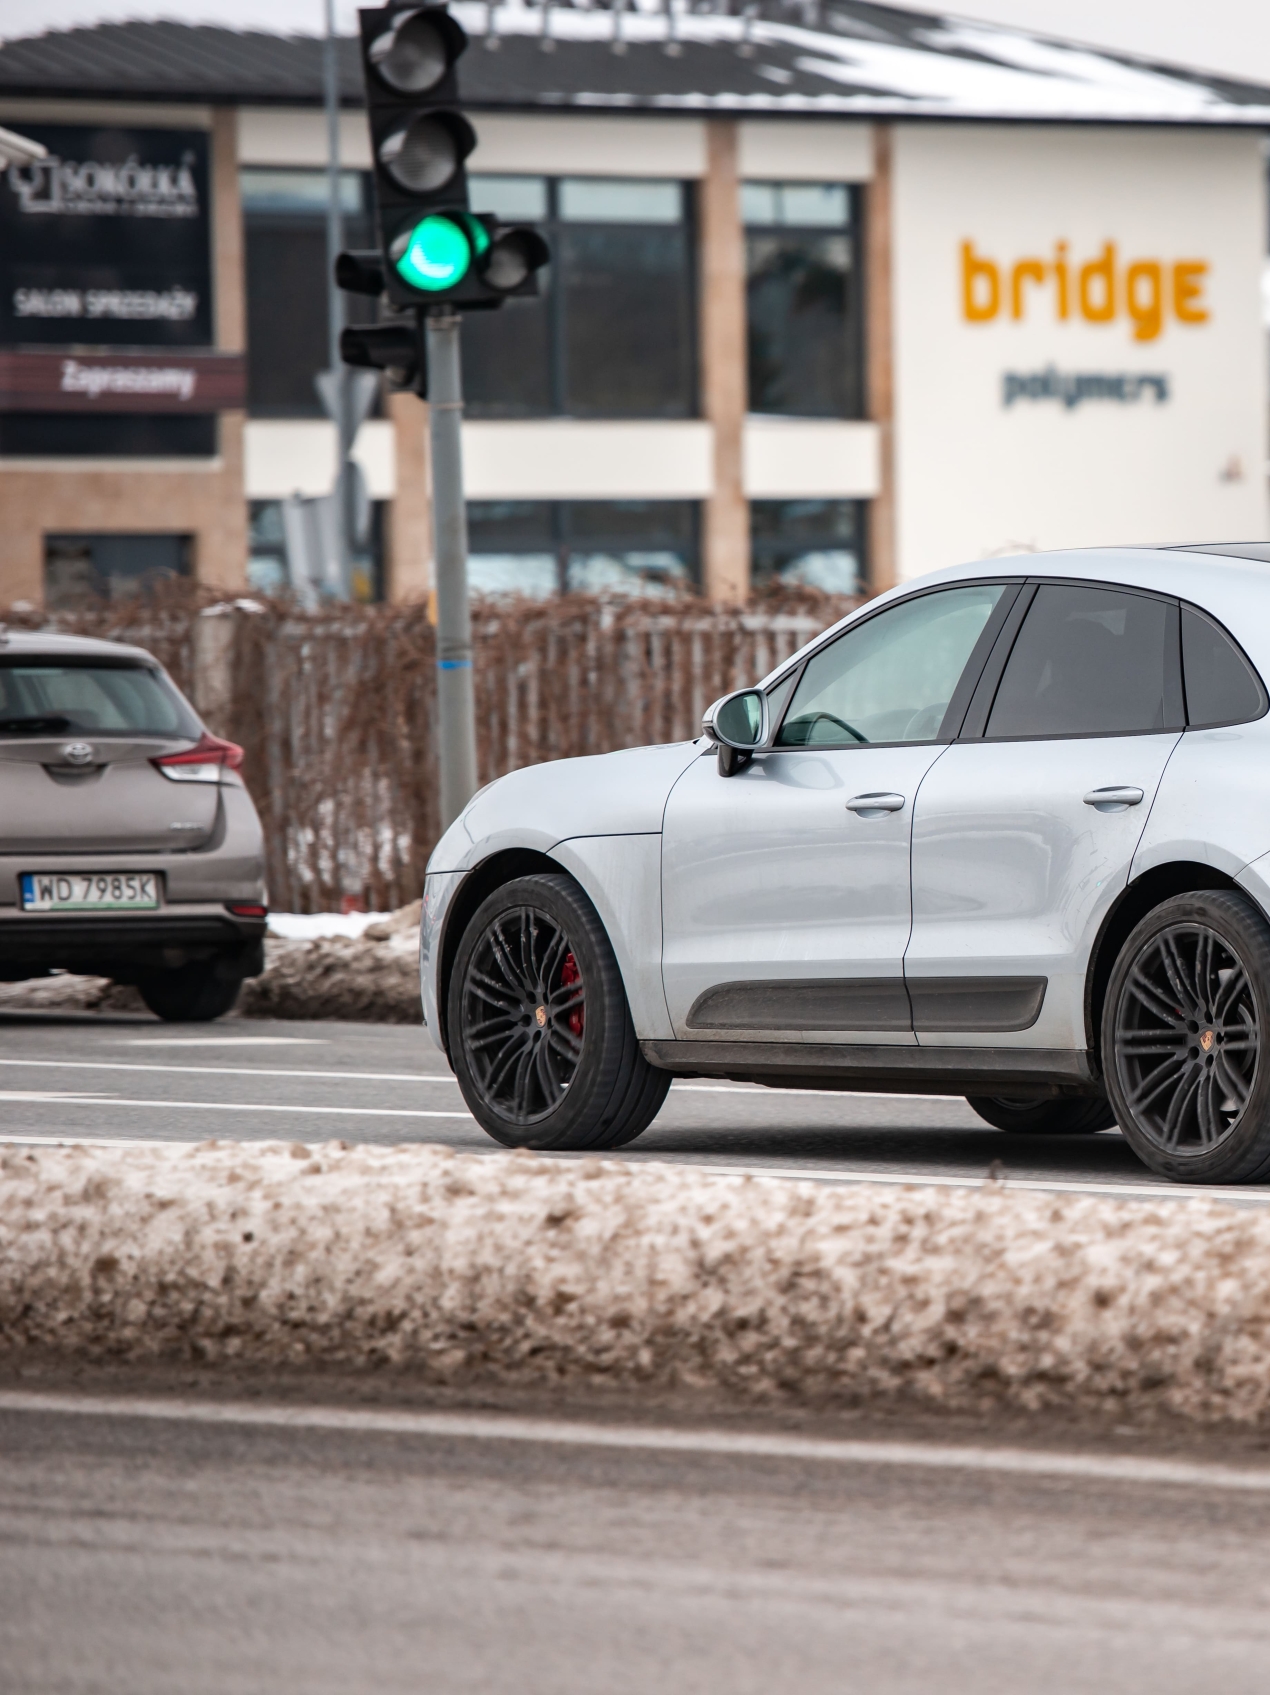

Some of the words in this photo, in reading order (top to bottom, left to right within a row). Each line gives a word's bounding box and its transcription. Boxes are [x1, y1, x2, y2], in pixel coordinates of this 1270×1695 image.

[14, 288, 82, 317] SALON
[960, 239, 1209, 341] bridge
[62, 360, 196, 400] Zapraszamy
[1002, 363, 1168, 408] polymers
[38, 877, 72, 900] WD
[79, 876, 153, 900] 7985K
